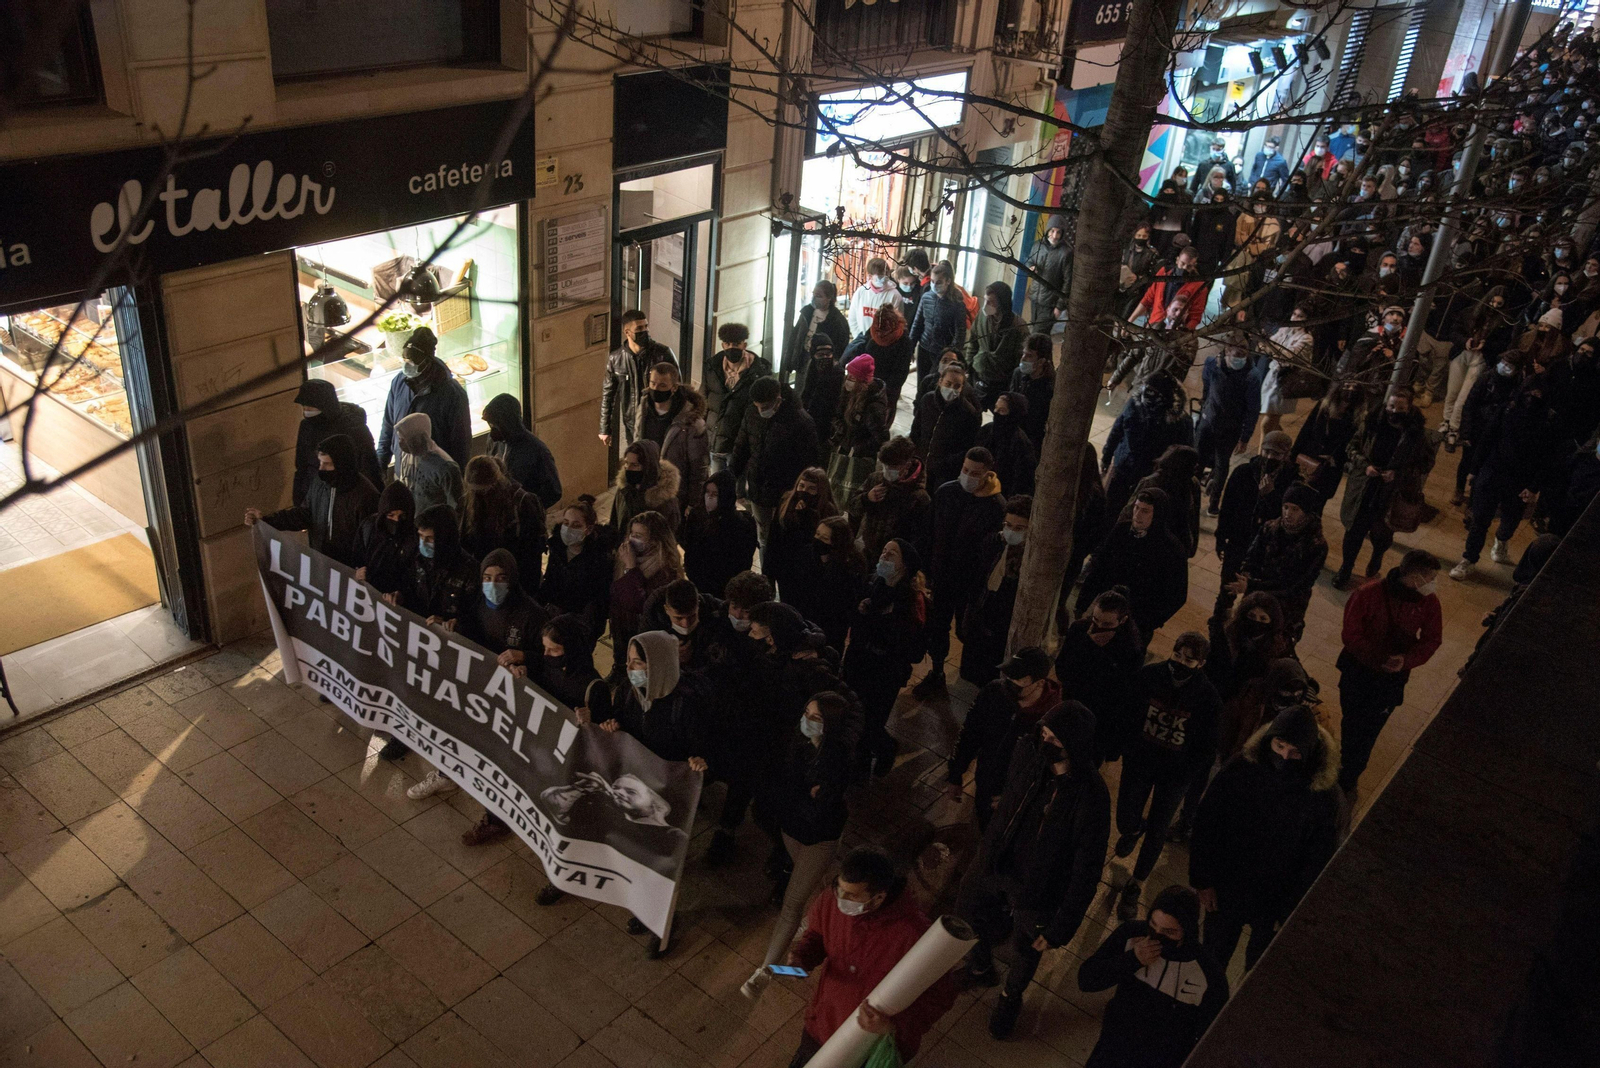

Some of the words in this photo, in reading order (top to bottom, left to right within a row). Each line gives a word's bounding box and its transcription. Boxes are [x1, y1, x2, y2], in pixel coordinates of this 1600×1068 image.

[1095, 3, 1122, 25] 655
[90, 179, 155, 253] el
[159, 160, 335, 237] taller
[269, 538, 580, 765] LLIBERTAT!
[316, 658, 459, 755] AMNISTIA
[406, 660, 531, 764] HASEL
[1147, 704, 1188, 731] FCK
[307, 670, 434, 755] ORGANITZEM
[441, 754, 465, 779] LA
[472, 777, 615, 890] SOLIDARITAT
